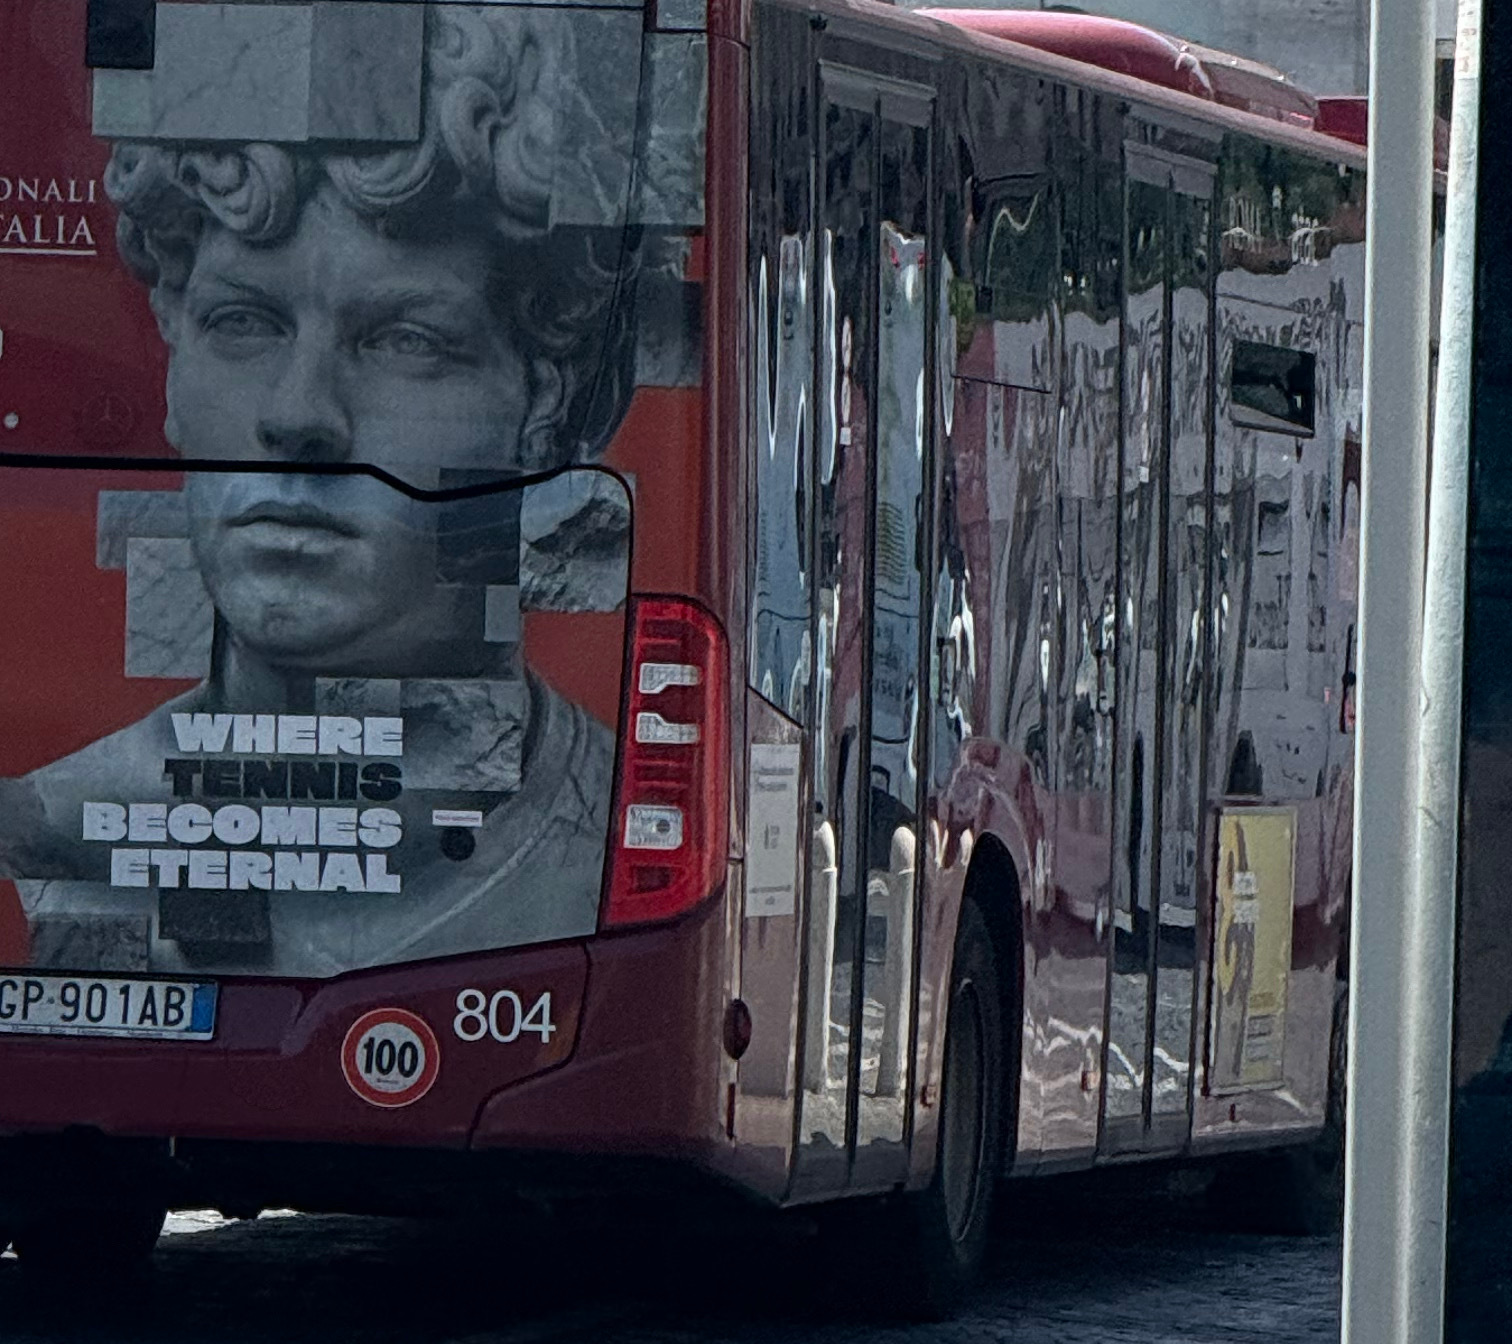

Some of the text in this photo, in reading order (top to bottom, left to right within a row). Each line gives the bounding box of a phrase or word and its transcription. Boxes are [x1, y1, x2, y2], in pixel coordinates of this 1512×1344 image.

[171, 713, 403, 756] WHERE
[164, 758, 402, 800] TENNIS
[83, 802, 402, 848] BECOMES
[110, 848, 402, 894] ETERNAL
[453, 988, 557, 1044] 804
[363, 1037, 419, 1078] 100
